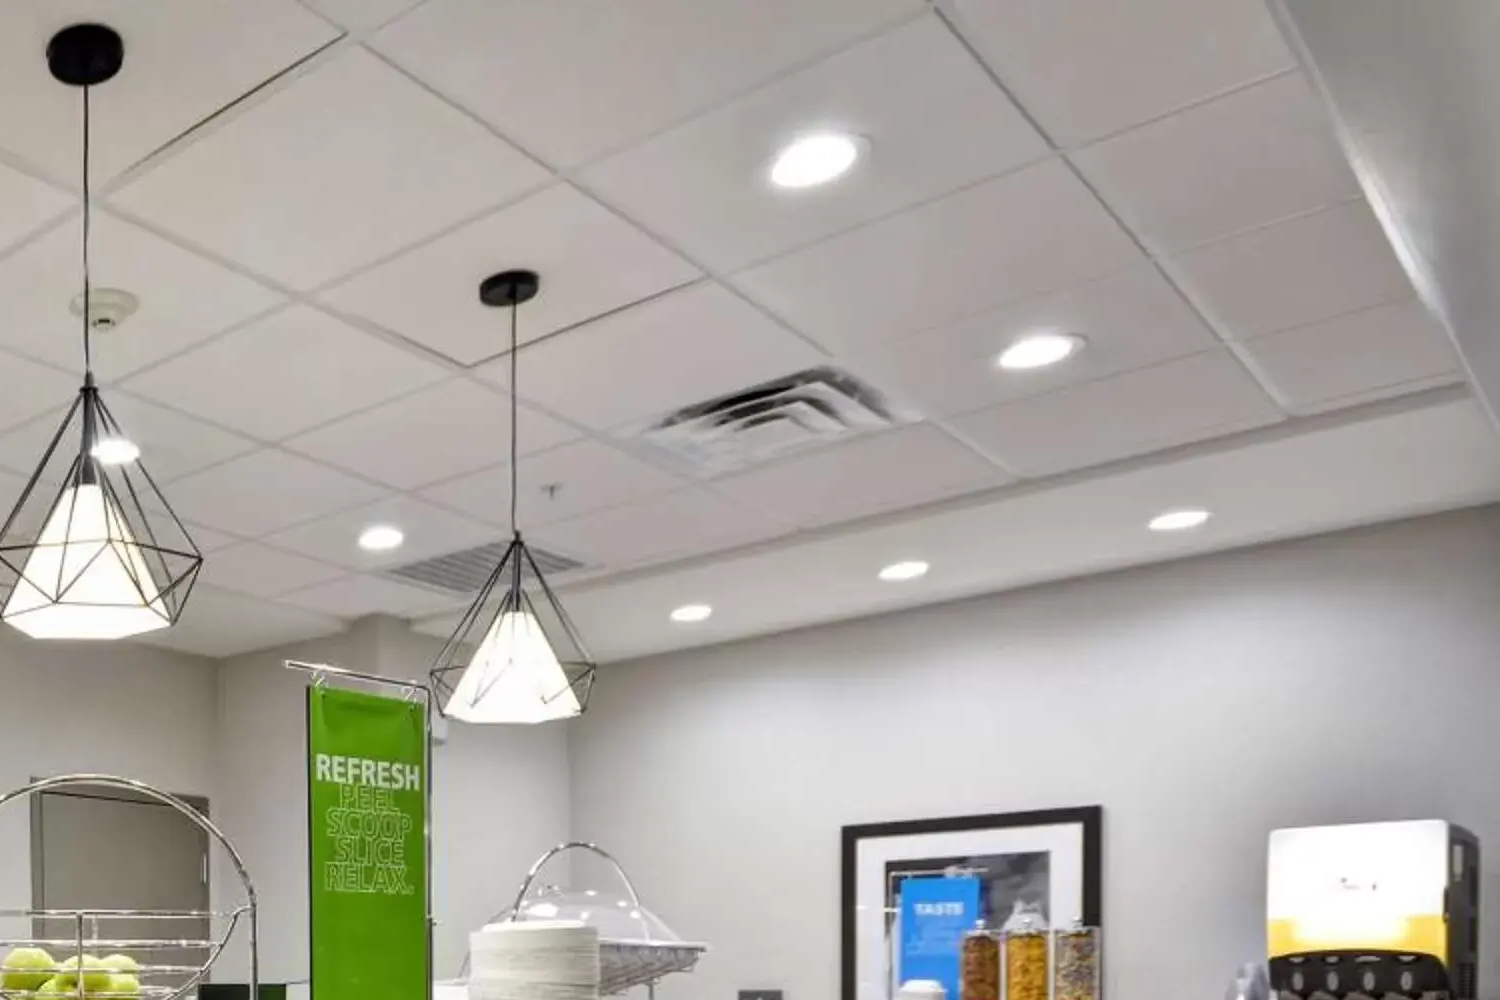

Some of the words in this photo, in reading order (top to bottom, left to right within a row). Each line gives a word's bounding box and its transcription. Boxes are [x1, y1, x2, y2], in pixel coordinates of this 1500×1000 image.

[316, 753, 420, 791] REFRESH
[340, 783, 400, 814] PEEL
[325, 806, 412, 841] SCOOP
[335, 837, 404, 868] SLICE
[324, 861, 416, 895] RELAX.
[913, 901, 965, 916] TASTE
